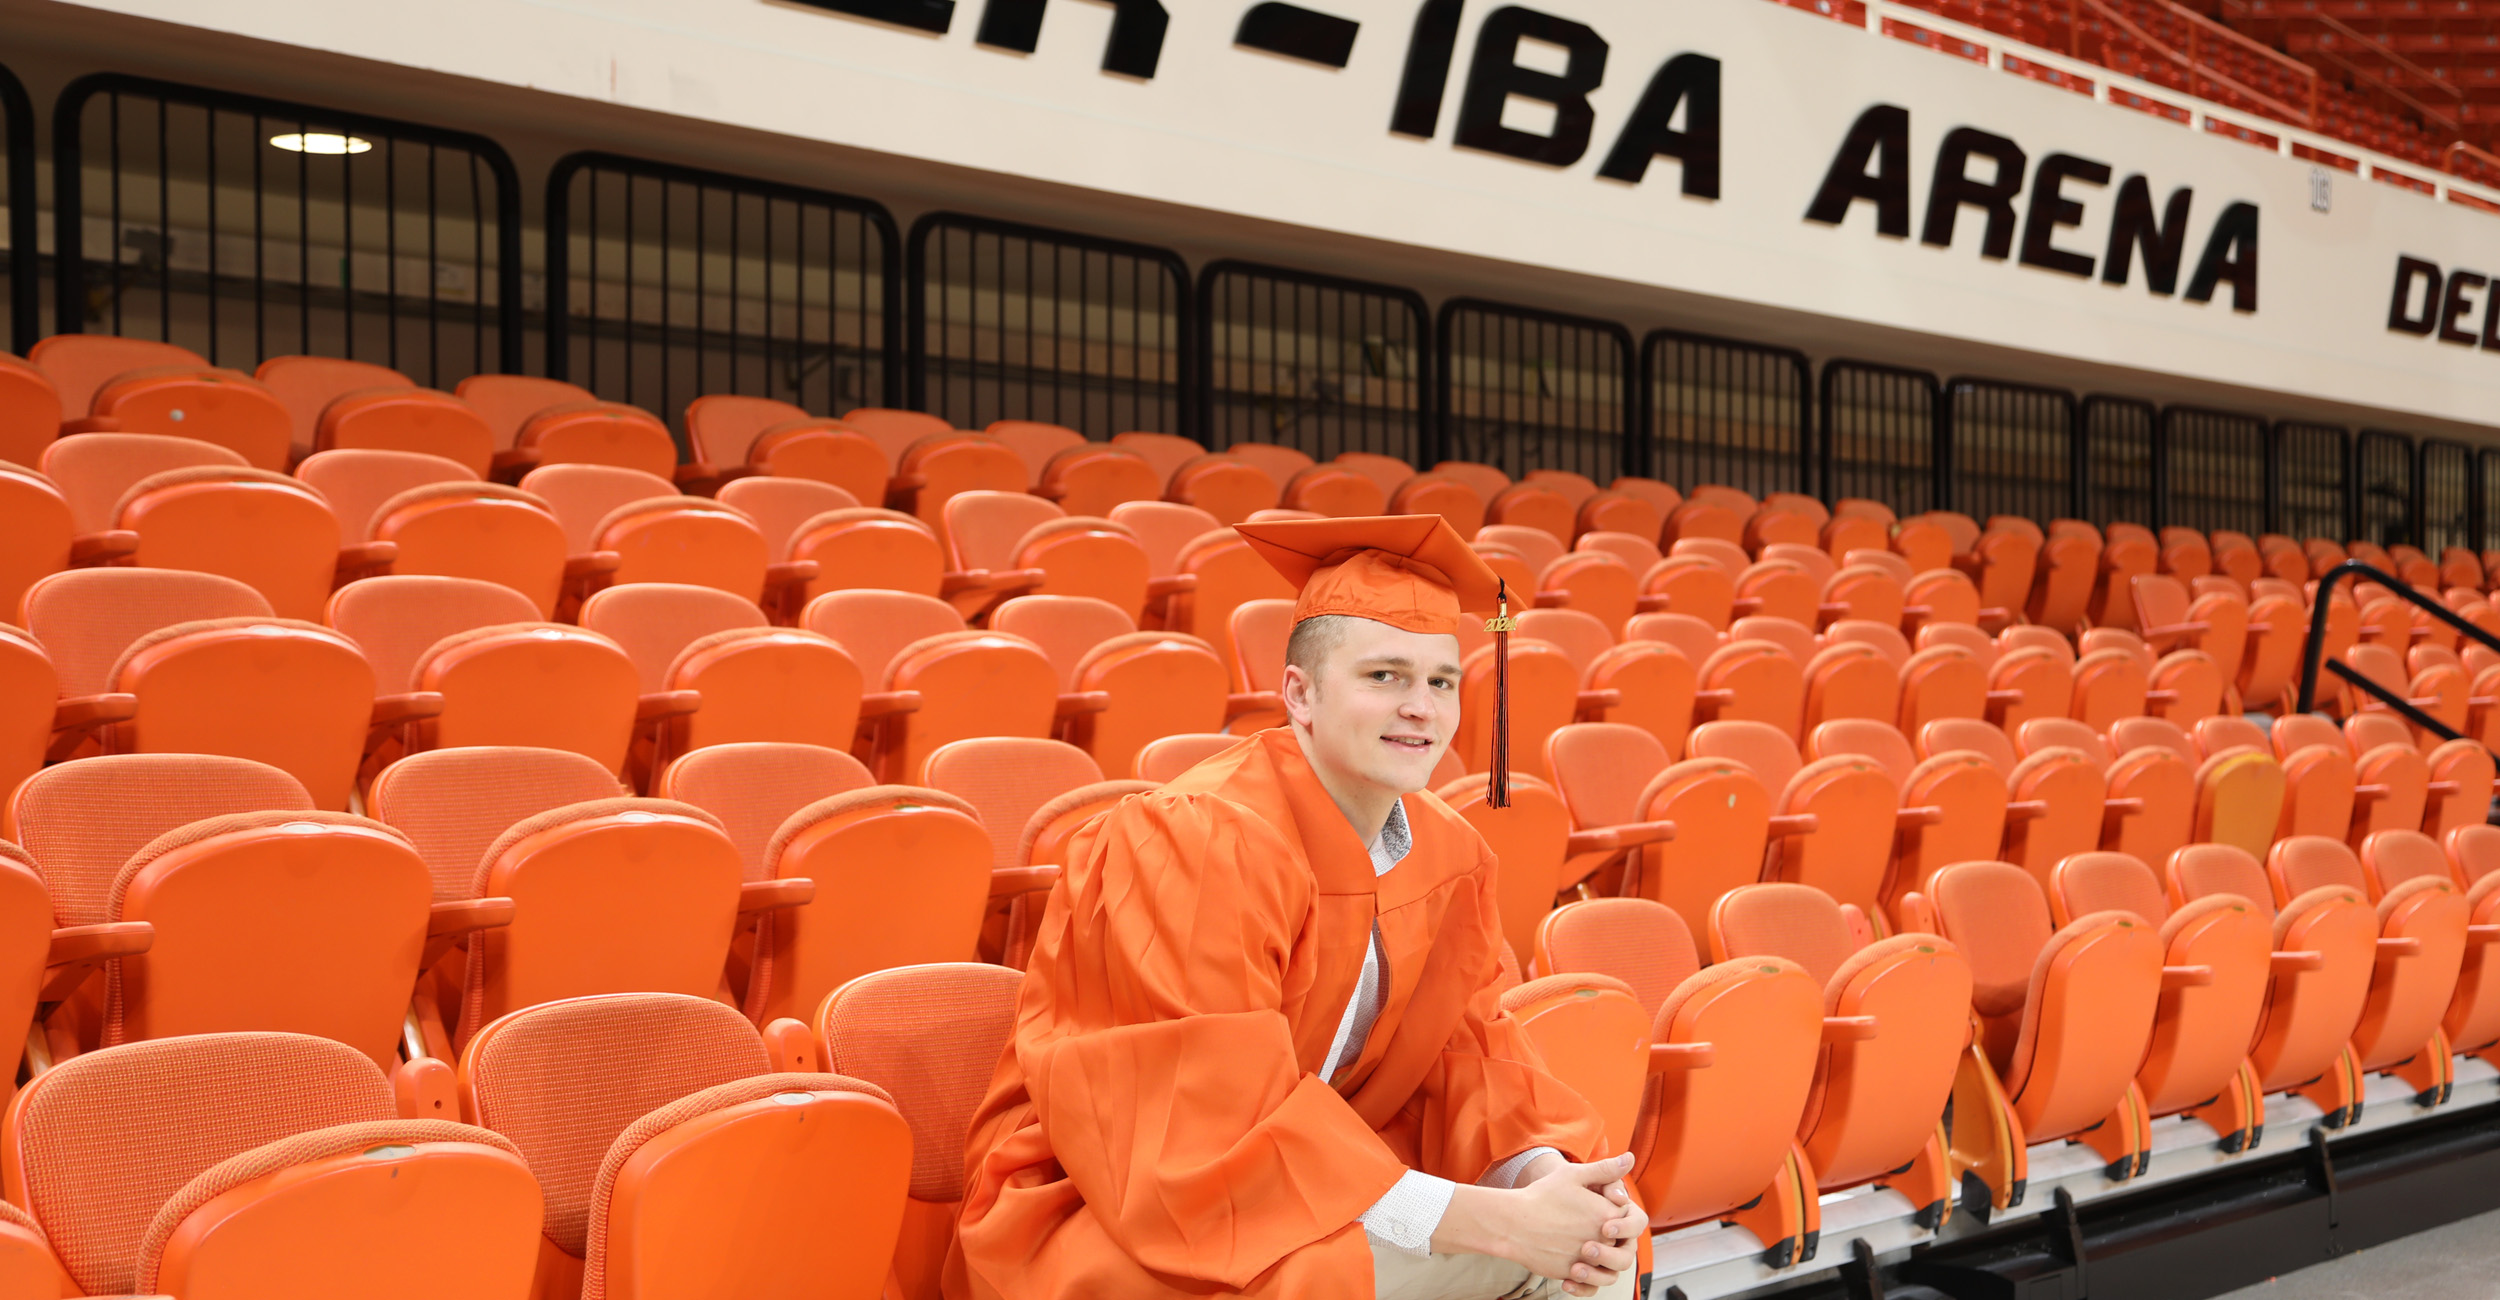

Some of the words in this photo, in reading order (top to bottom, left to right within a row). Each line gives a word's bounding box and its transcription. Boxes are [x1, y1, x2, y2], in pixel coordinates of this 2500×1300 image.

[757, 0, 1721, 202] -IBA
[1803, 103, 2258, 313] ARENA
[1483, 617, 1517, 632] 2024
